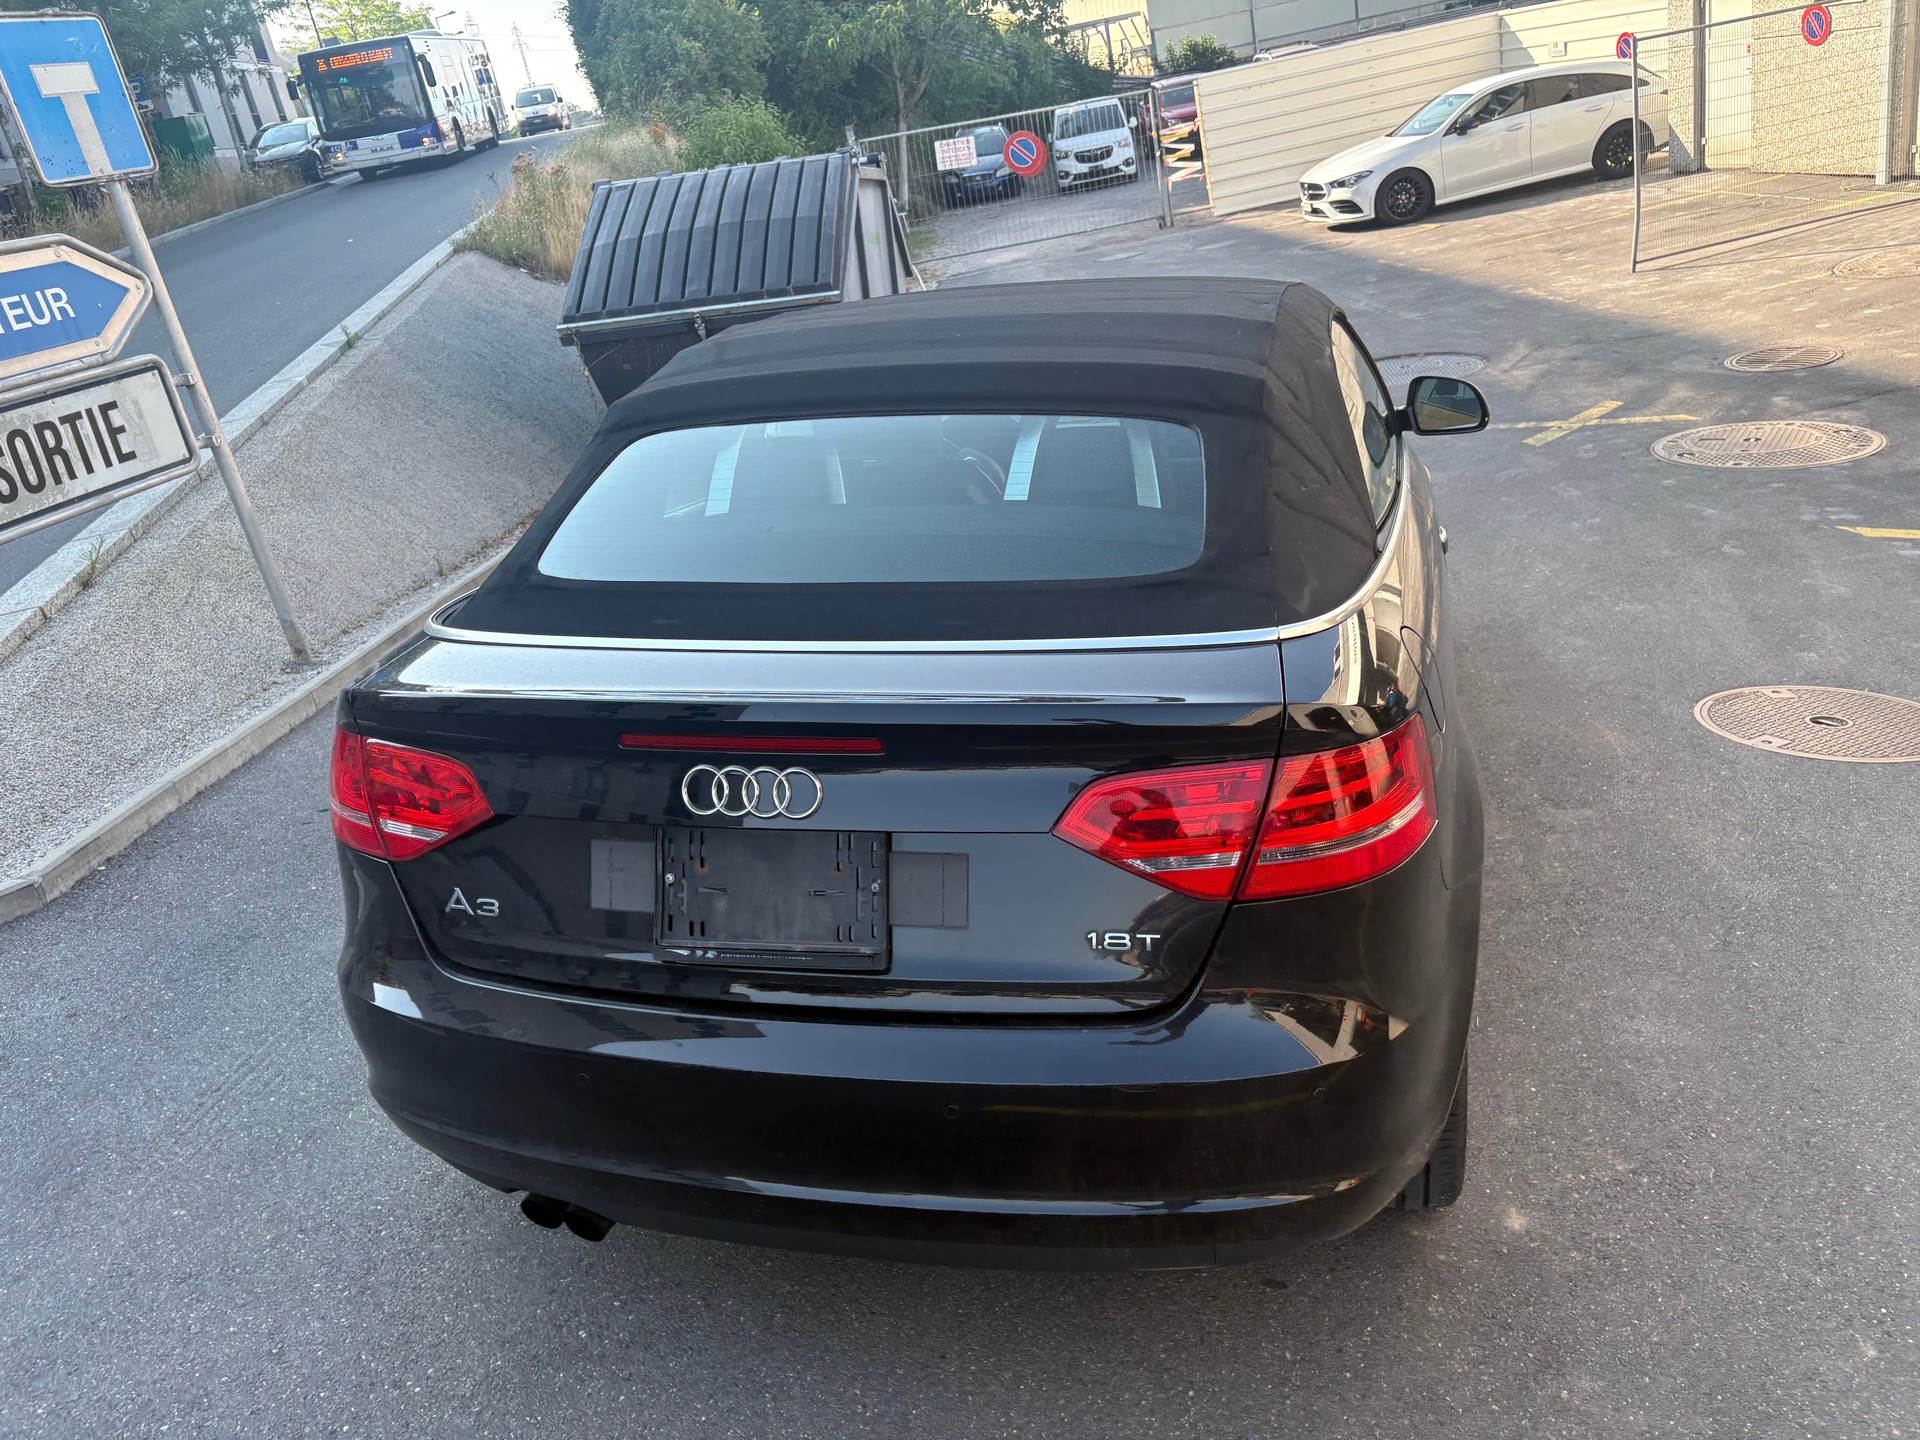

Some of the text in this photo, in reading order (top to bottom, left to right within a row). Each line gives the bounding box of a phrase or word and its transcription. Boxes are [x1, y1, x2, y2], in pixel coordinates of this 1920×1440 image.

[370, 145, 394, 153] MAN
[0, 287, 76, 334] EUR
[445, 887, 499, 917] A3
[1087, 932, 1160, 951] 1.8 T
